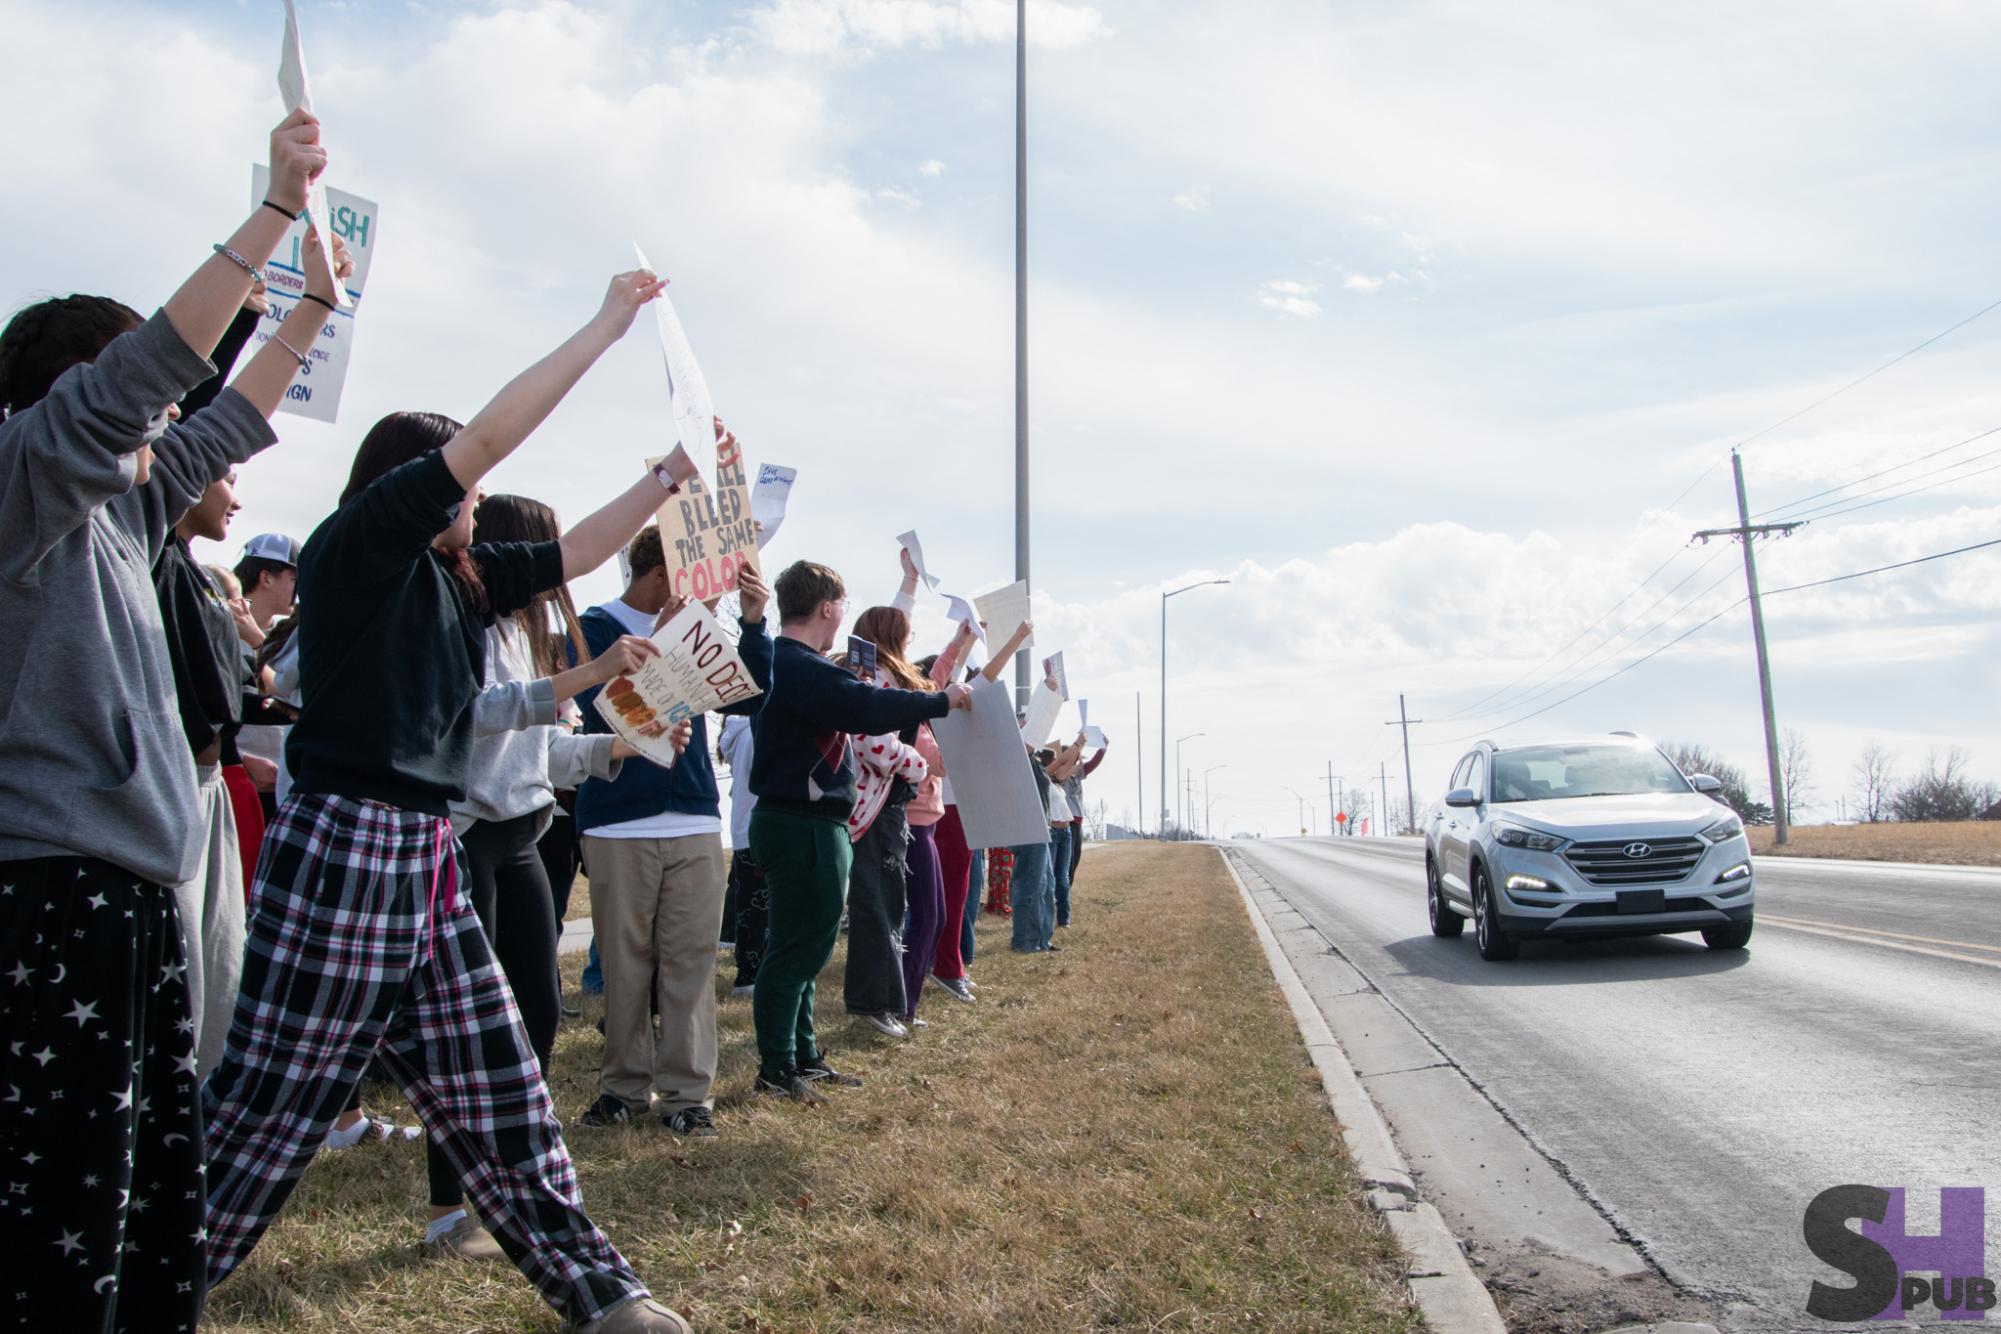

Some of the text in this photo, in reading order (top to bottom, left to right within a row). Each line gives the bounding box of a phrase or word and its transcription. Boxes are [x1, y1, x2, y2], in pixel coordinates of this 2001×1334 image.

[267, 269, 304, 289] BORDERS
[679, 489, 742, 537] BLEED
[674, 519, 755, 568] THE SAME
[682, 618, 724, 669] NO
